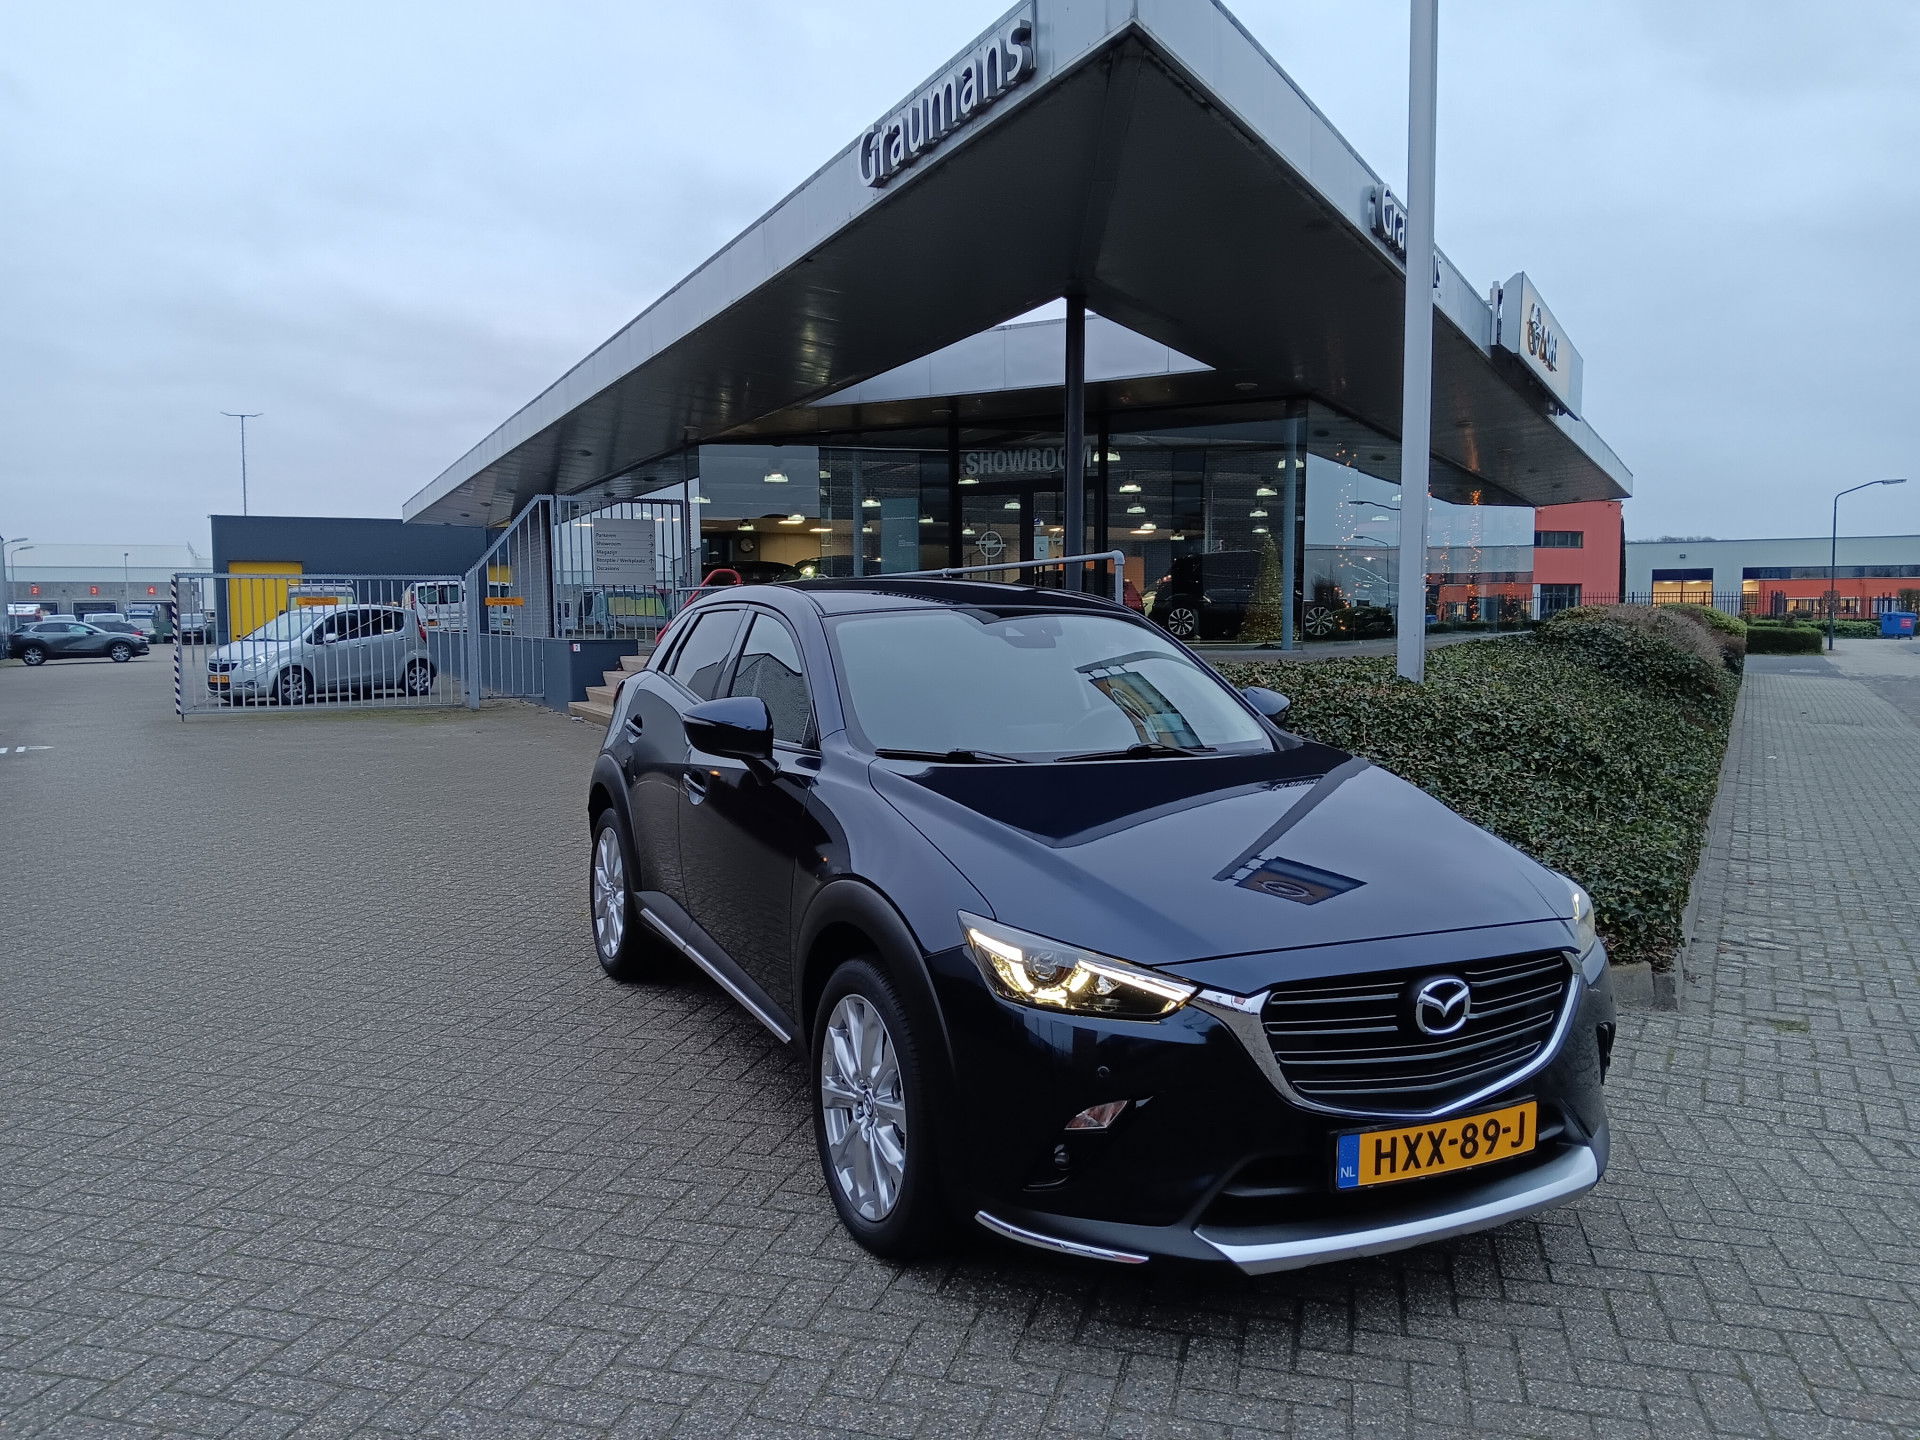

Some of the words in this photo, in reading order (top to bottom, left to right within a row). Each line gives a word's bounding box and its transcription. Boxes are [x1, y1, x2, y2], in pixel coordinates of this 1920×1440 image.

[858, 19, 1032, 187] Graumans
[1340, 1166, 1356, 1179] NL
[1374, 1110, 1526, 1176] HXX-89-J
